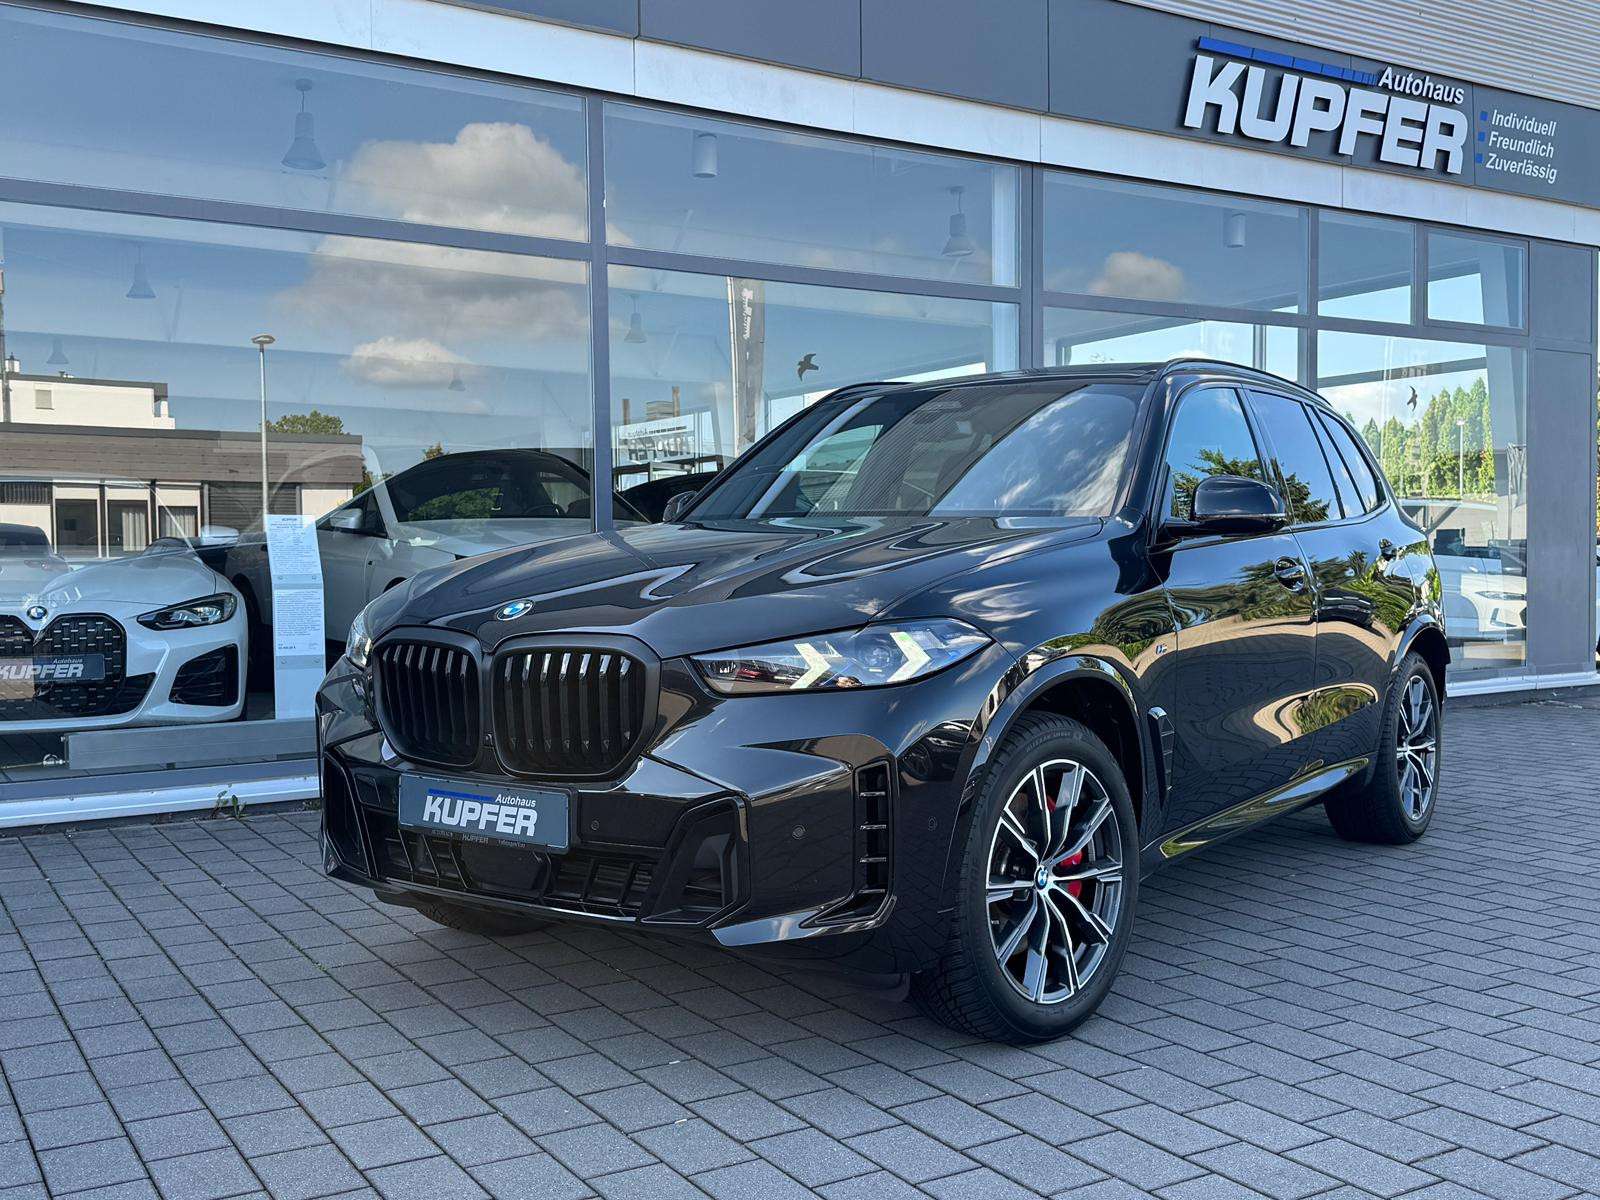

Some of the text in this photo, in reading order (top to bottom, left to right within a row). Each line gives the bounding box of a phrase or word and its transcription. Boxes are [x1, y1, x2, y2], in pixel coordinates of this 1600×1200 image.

[1378, 67, 1465, 104] Autohaus
[1184, 55, 1469, 175] KUPFER
[1491, 109, 1557, 137] Individuell
[1488, 131, 1555, 159] Freundlich
[1485, 153, 1558, 185] Zuverlässig
[422, 795, 538, 837] KUPFER
[494, 793, 536, 807] Autohaus
